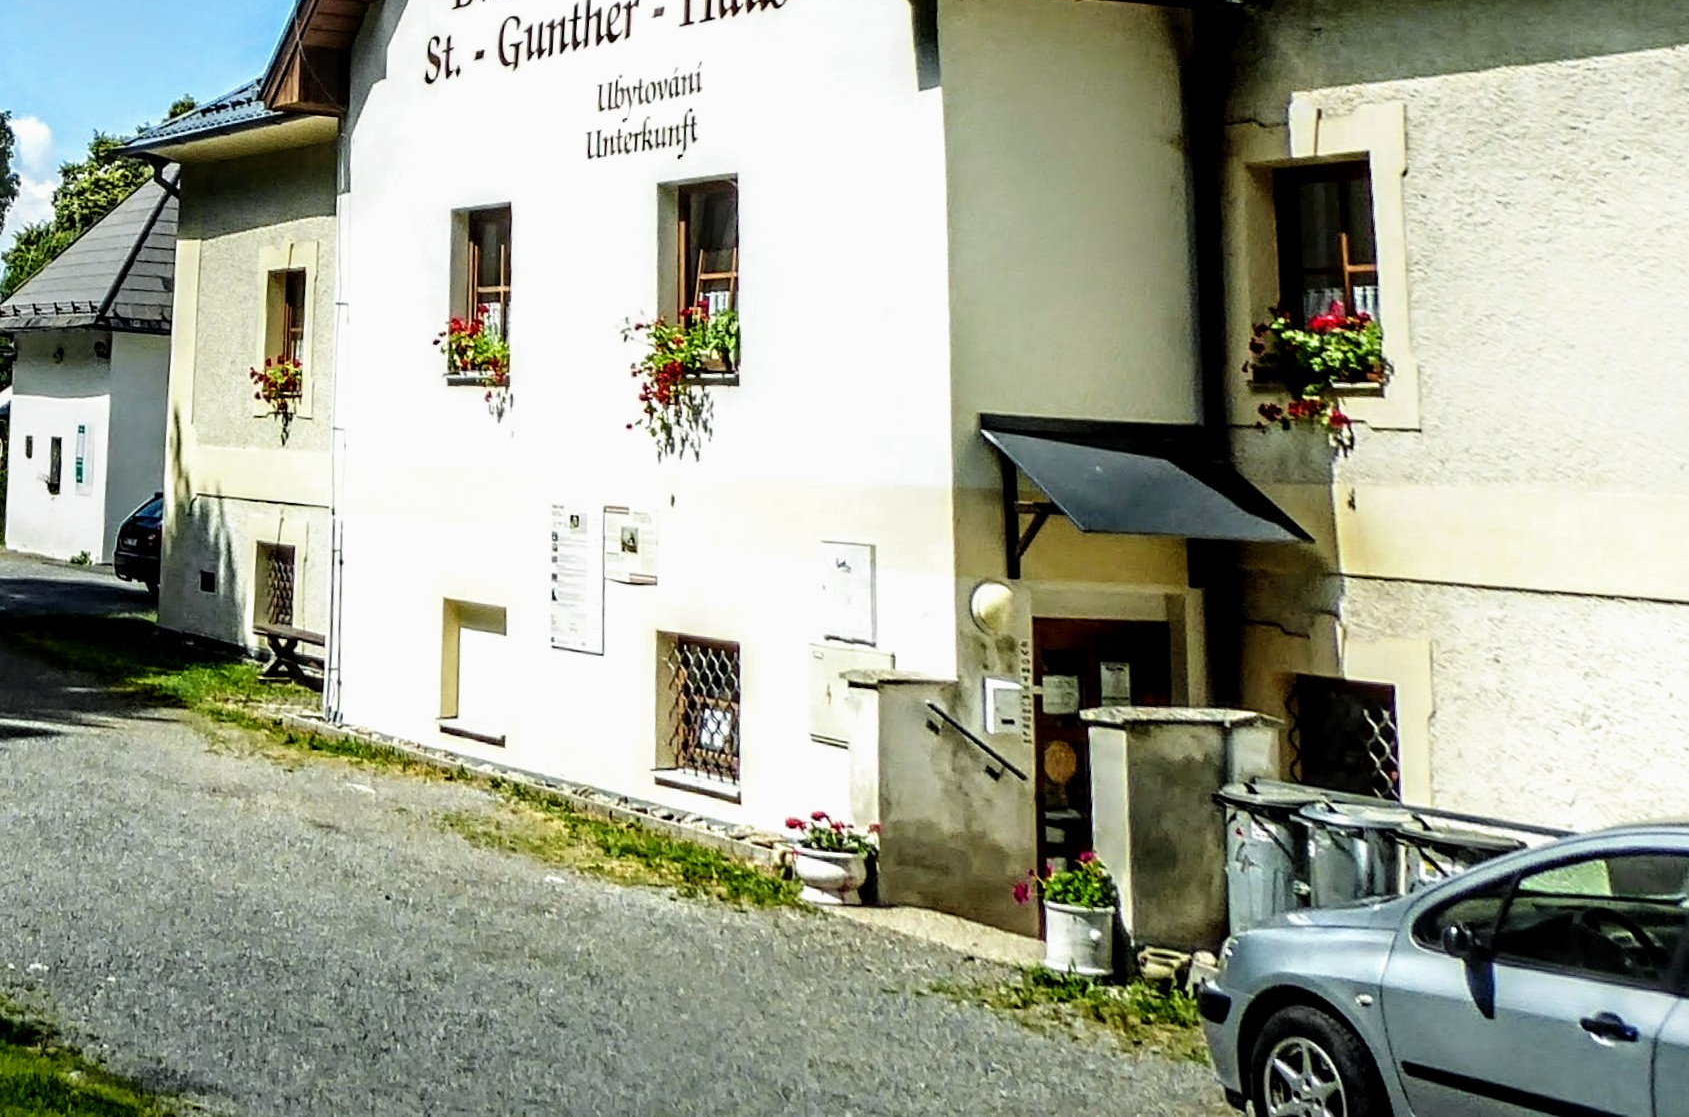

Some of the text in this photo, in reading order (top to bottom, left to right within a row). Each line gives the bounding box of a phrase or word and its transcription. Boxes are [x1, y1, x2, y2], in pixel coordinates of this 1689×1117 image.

[424, 34, 462, 85] St.
[597, 61, 703, 123] Ubytování
[586, 108, 698, 160] Unterkunft
